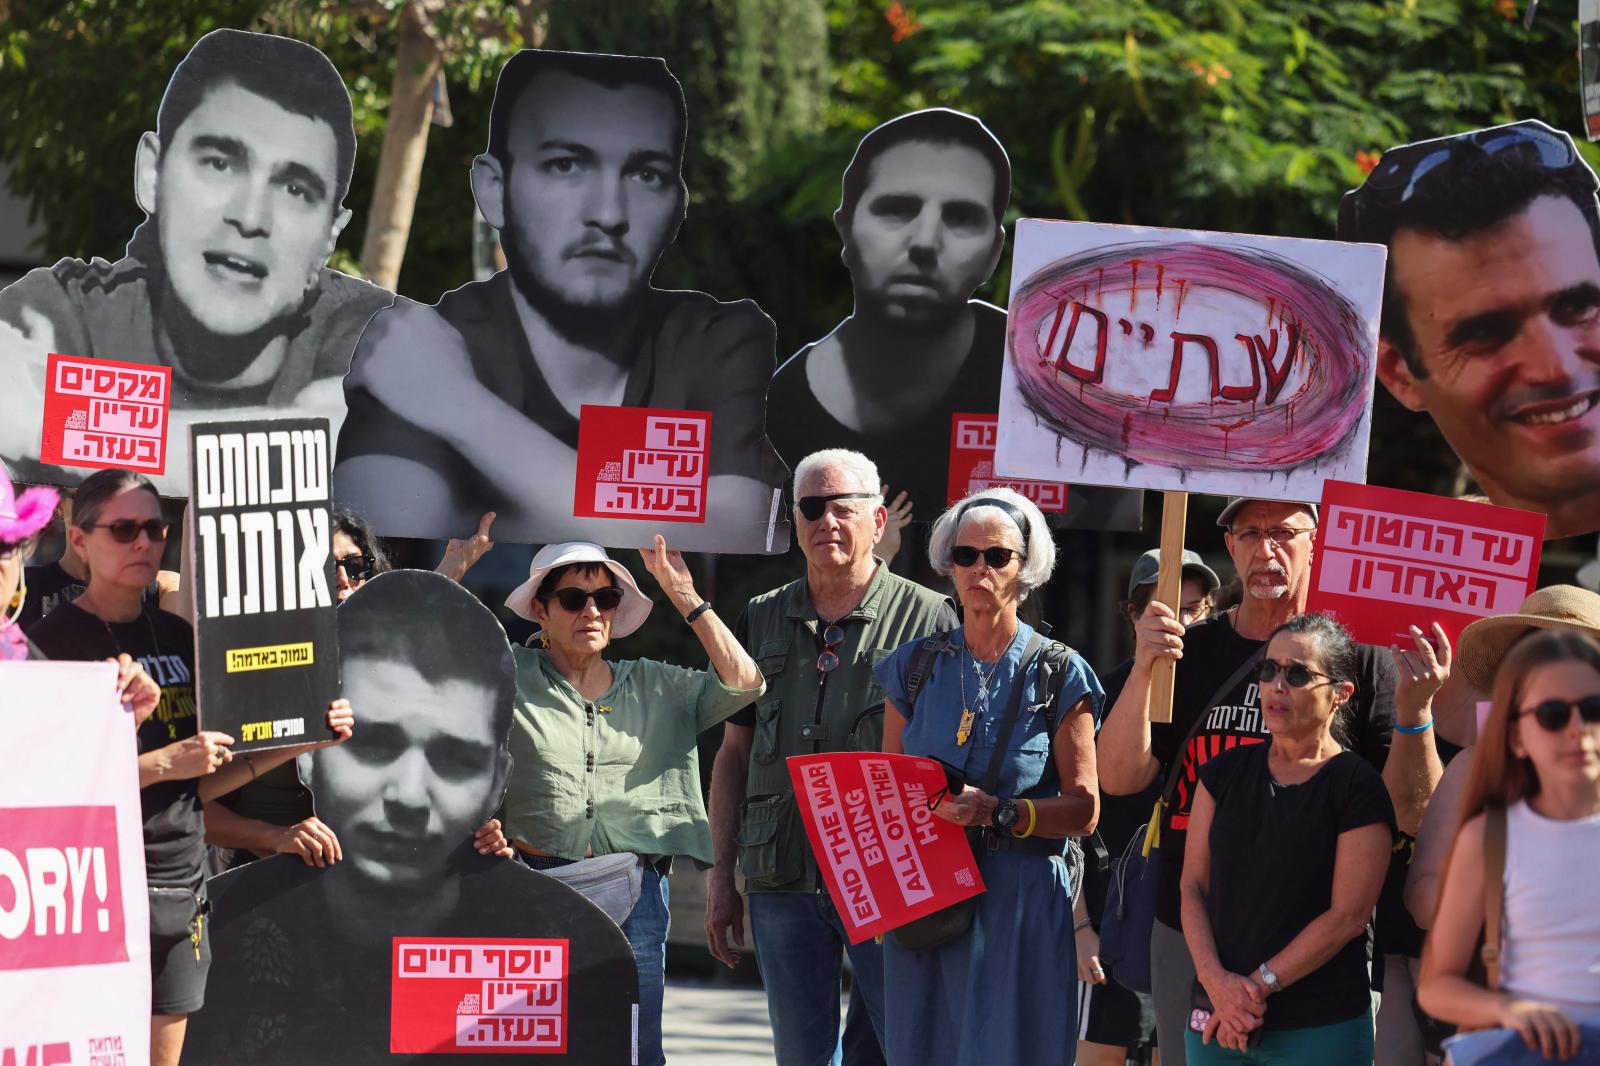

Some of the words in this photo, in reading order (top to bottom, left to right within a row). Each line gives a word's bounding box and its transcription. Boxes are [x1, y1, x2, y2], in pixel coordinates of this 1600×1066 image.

[61, 365, 162, 400] מקסים
[93, 401, 160, 430] עדיין
[74, 433, 158, 464] בעזה.
[655, 421, 700, 448] בר
[196, 429, 329, 509] שכחתם
[627, 451, 700, 480] עדיין
[606, 486, 698, 513] בעזה.
[1336, 510, 1465, 557] החטוף
[1471, 531, 1523, 566] עד
[198, 507, 333, 618] אותנו
[1348, 558, 1498, 610] האחרון
[232, 650, 278, 668] באדמה!
[280, 647, 308, 666] עמוק
[1205, 705, 1260, 733] הביתה
[808, 765, 834, 809] WAR
[868, 762, 895, 806] THEM
[845, 788, 885, 868] BRING
[881, 808, 904, 841] OF
[904, 782, 939, 846] HOME
[821, 811, 851, 865] THE
[896, 844, 926, 891] ALL
[842, 868, 875, 921] END
[403, 948, 473, 974] חיים
[483, 949, 552, 978] יוסף
[487, 982, 558, 1011] עדיין
[467, 1018, 559, 1042] בעזה.
